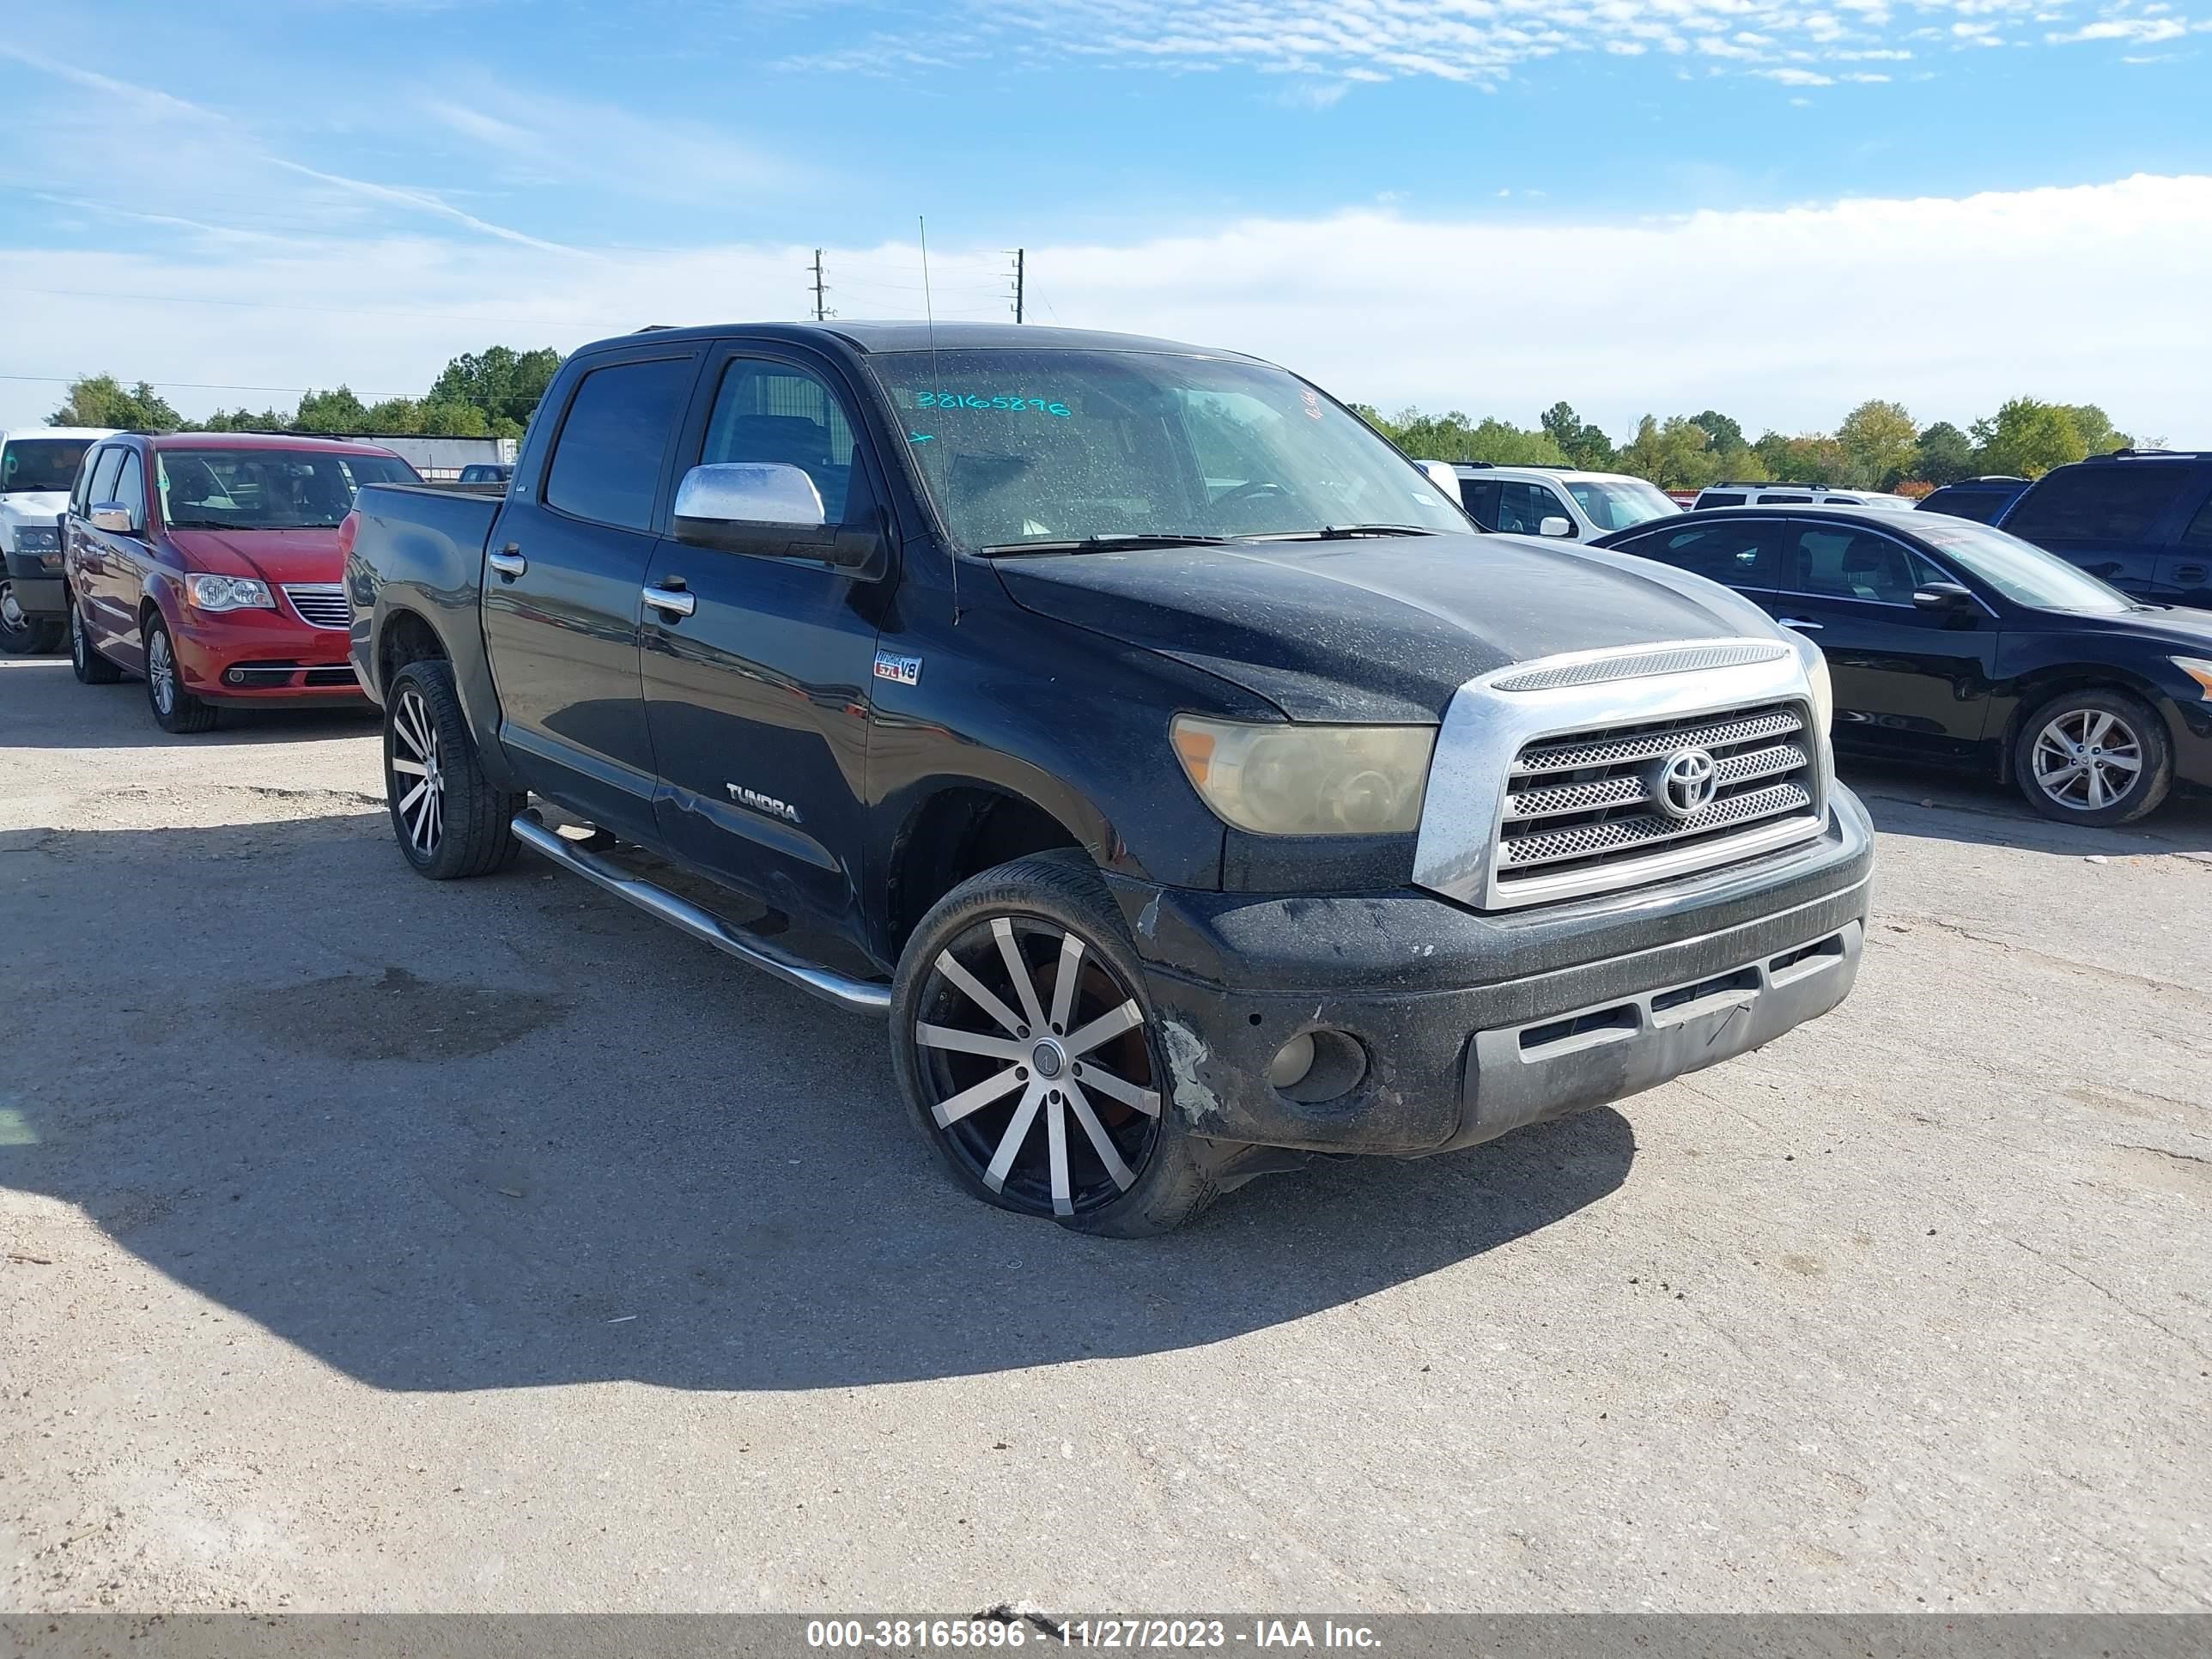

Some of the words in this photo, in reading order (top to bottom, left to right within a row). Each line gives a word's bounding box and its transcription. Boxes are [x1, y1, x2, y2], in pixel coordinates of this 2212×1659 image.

[917, 392, 1073, 416] 38165896
[901, 660, 916, 679] V8
[726, 782, 802, 823] TUNDRA
